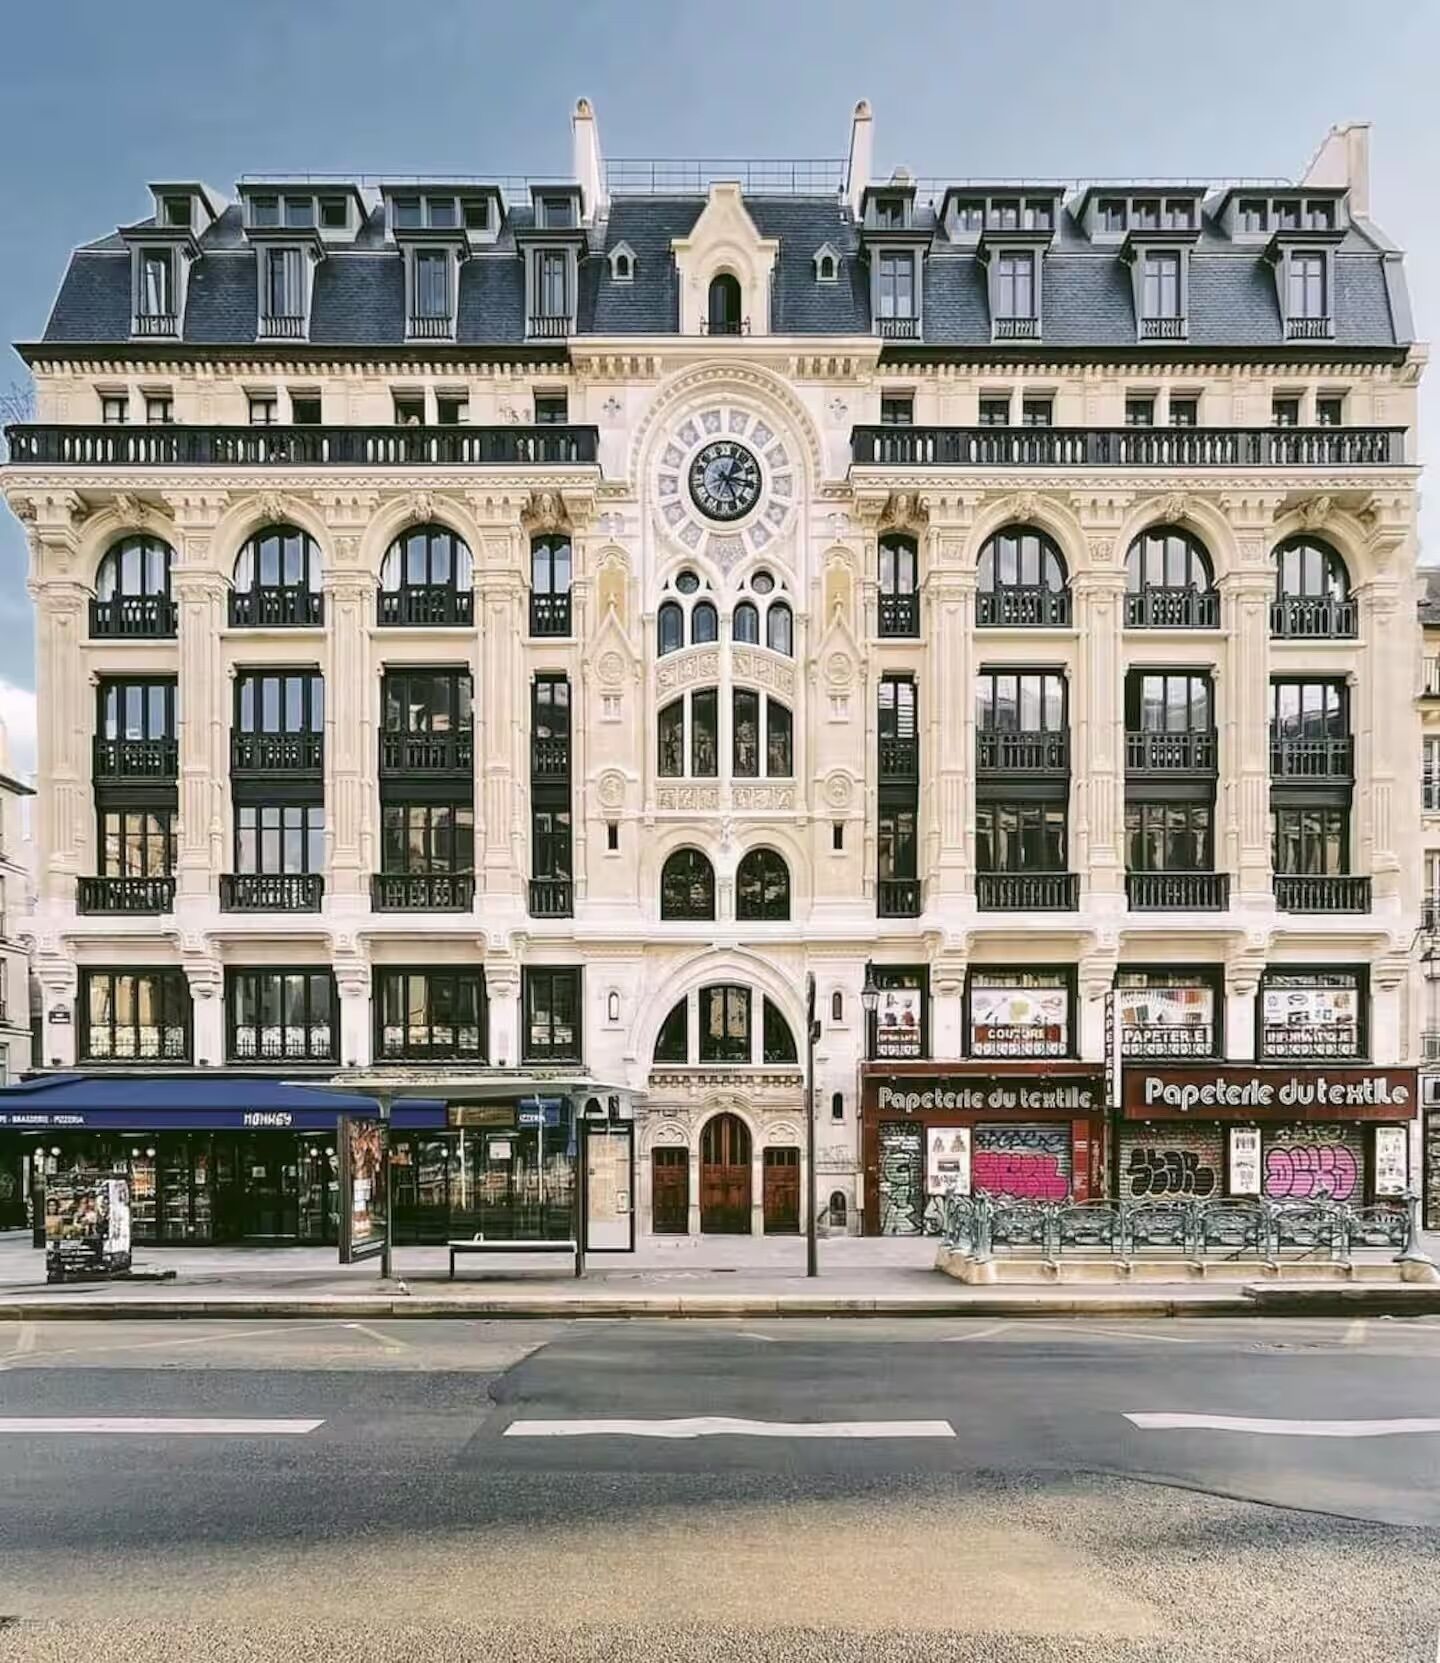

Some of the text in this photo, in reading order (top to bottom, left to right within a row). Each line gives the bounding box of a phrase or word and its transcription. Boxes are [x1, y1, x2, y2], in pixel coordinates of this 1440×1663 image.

[878, 1086, 985, 1113] Papeterie
[988, 1087, 1017, 1109] du
[1145, 1076, 1275, 1111] Papeterie
[1278, 1077, 1315, 1106] du
[243, 1112, 293, 1126] MONKEY
